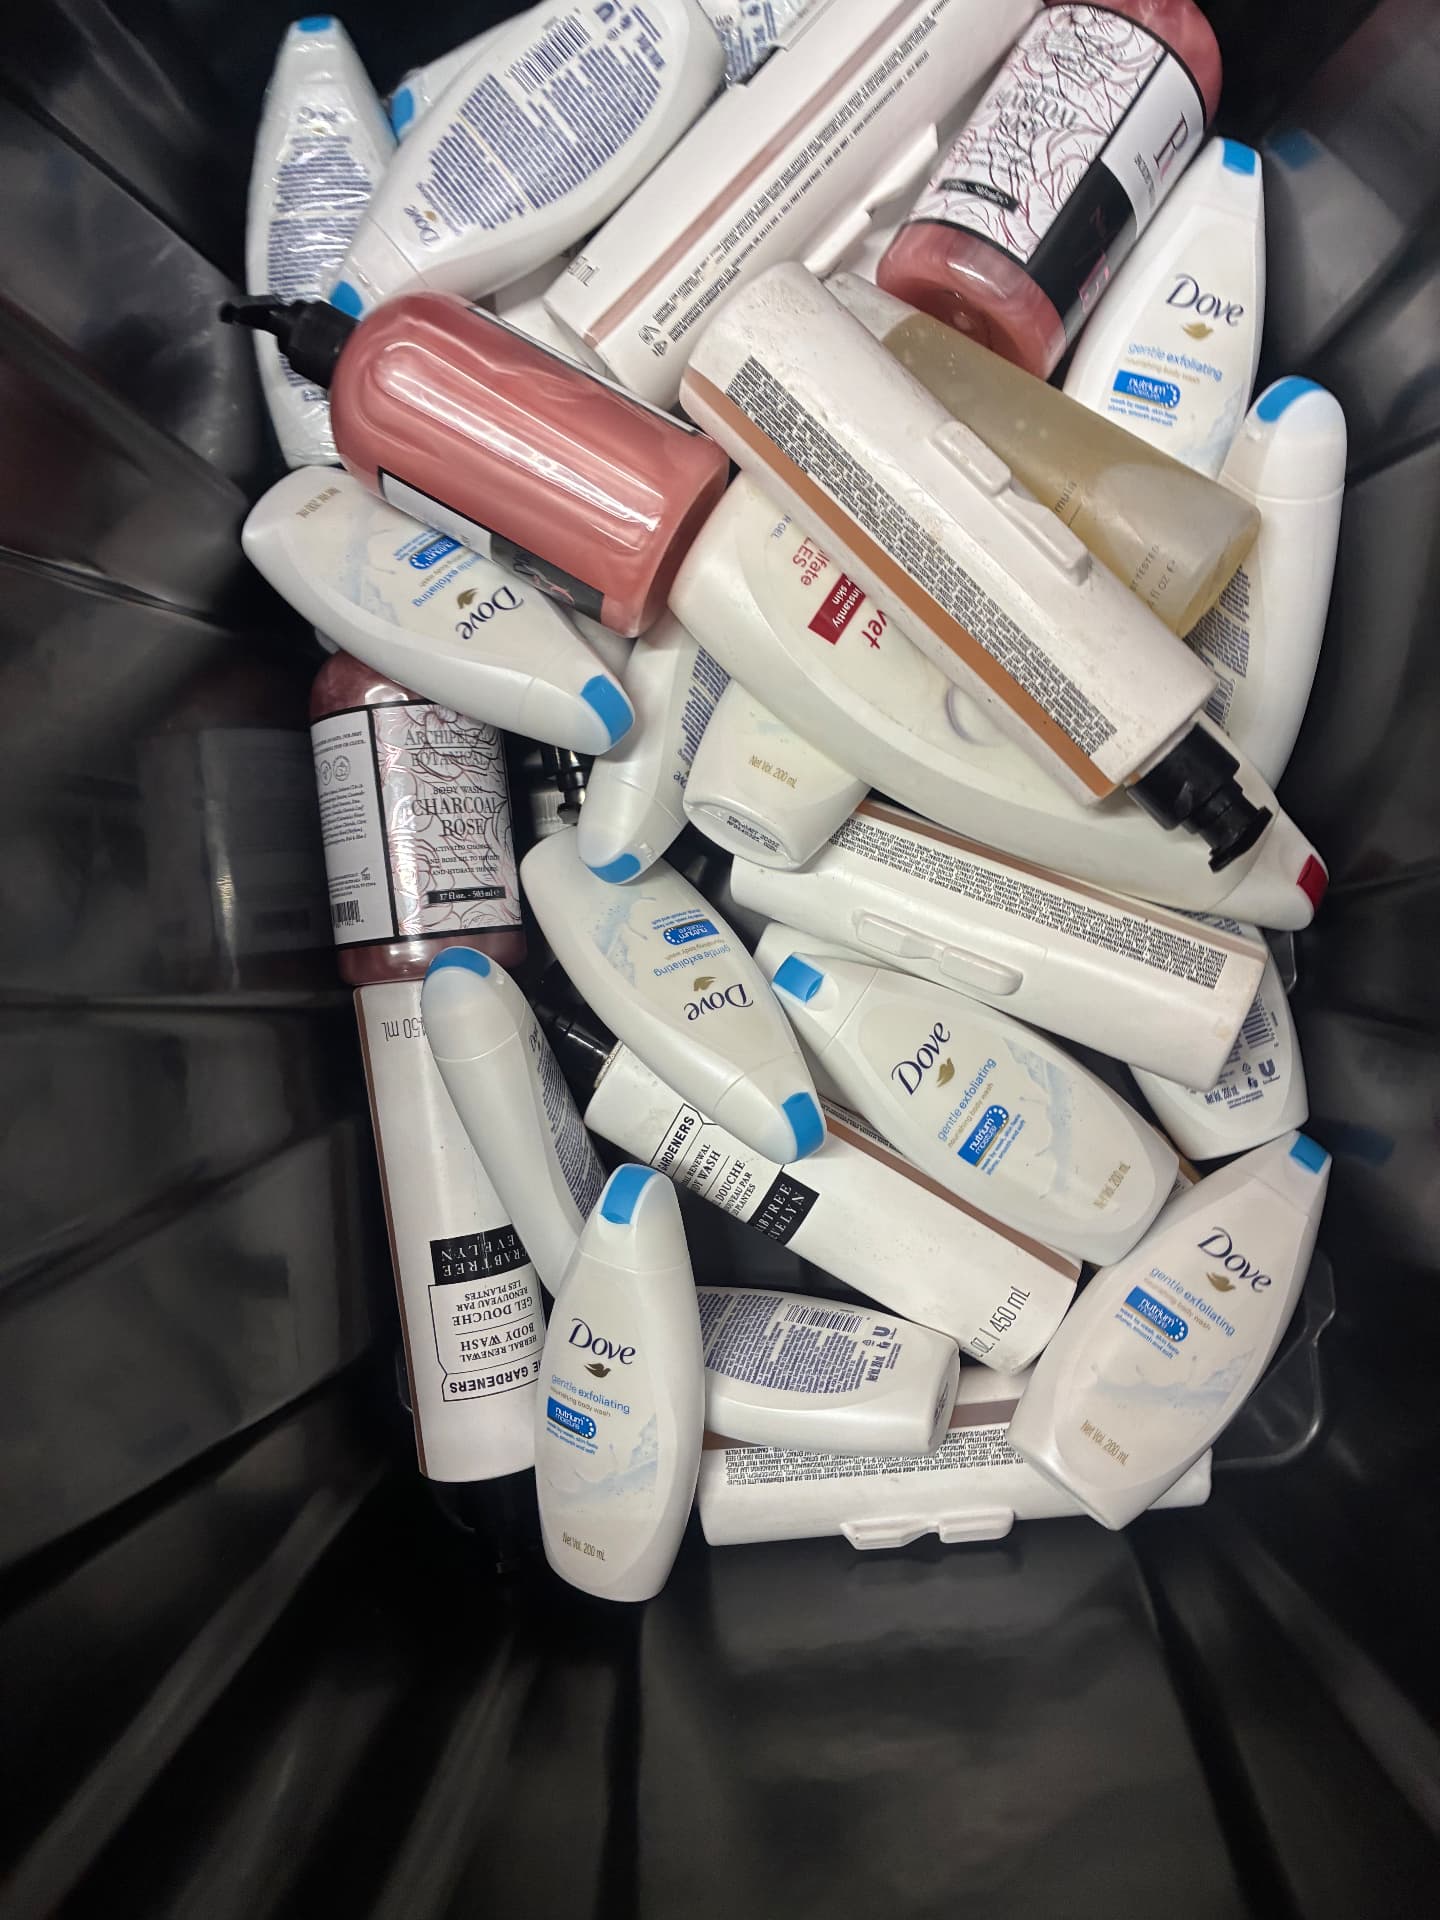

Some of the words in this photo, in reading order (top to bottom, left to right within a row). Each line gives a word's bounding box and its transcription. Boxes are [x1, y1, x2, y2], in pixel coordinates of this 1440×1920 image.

[404, 204, 440, 247] Dove
[1166, 273, 1244, 327] Dove
[1128, 343, 1165, 361] gentle
[1166, 352, 1223, 382] exfoliating
[412, 569, 458, 607] exfoliating
[832, 585, 848, 605] skin
[455, 586, 523, 640] Dove
[832, 587, 861, 628] instantly
[773, 767, 788, 781] 200
[411, 797, 501, 817] CHARCOAL
[442, 818, 485, 836] ROSE
[678, 927, 708, 940] nutrium
[653, 950, 703, 977] exfoliating
[684, 984, 753, 1020] Dove
[891, 1022, 950, 1095] Dove
[938, 1107, 962, 1142] gentle
[959, 1058, 997, 1109] exfoliating
[657, 1116, 695, 1171] GARDENERS
[969, 1117, 994, 1151] nutrium
[975, 1125, 997, 1155] moisture
[687, 1143, 711, 1180] RENEWAL
[698, 1150, 721, 1180] WASH
[715, 1160, 746, 1202] DOUCHE
[739, 1171, 752, 1188] PAR
[735, 1183, 756, 1211] PLANTES
[442, 1234, 514, 1262] EVELYN
[1197, 1226, 1272, 1293] Dove
[465, 1284, 506, 1301] PLANTES
[479, 1286, 528, 1309] RENOUVEAU
[508, 1280, 521, 1288] LES
[452, 1304, 512, 1326] DOUCHE
[456, 1303, 475, 1312] PAR
[514, 1296, 533, 1311] GEL
[990, 1306, 1017, 1333] 450
[1007, 1286, 1031, 1311] mL
[1141, 1298, 1175, 1328] nutrium
[1151, 1267, 1185, 1294] gentle
[1184, 1291, 1236, 1338] exfoliating
[460, 1335, 502, 1351] WASH
[506, 1322, 535, 1342] BODY
[508, 1334, 537, 1352] HERBAL
[568, 1318, 636, 1365] Dove
[459, 1345, 507, 1363] RENEWAL
[450, 1366, 528, 1394] GARDENERS
[551, 1374, 577, 1394] gentle
[578, 1387, 630, 1415] exfoliating
[555, 1407, 584, 1426] nutrium
[555, 1413, 580, 1430] moisture
